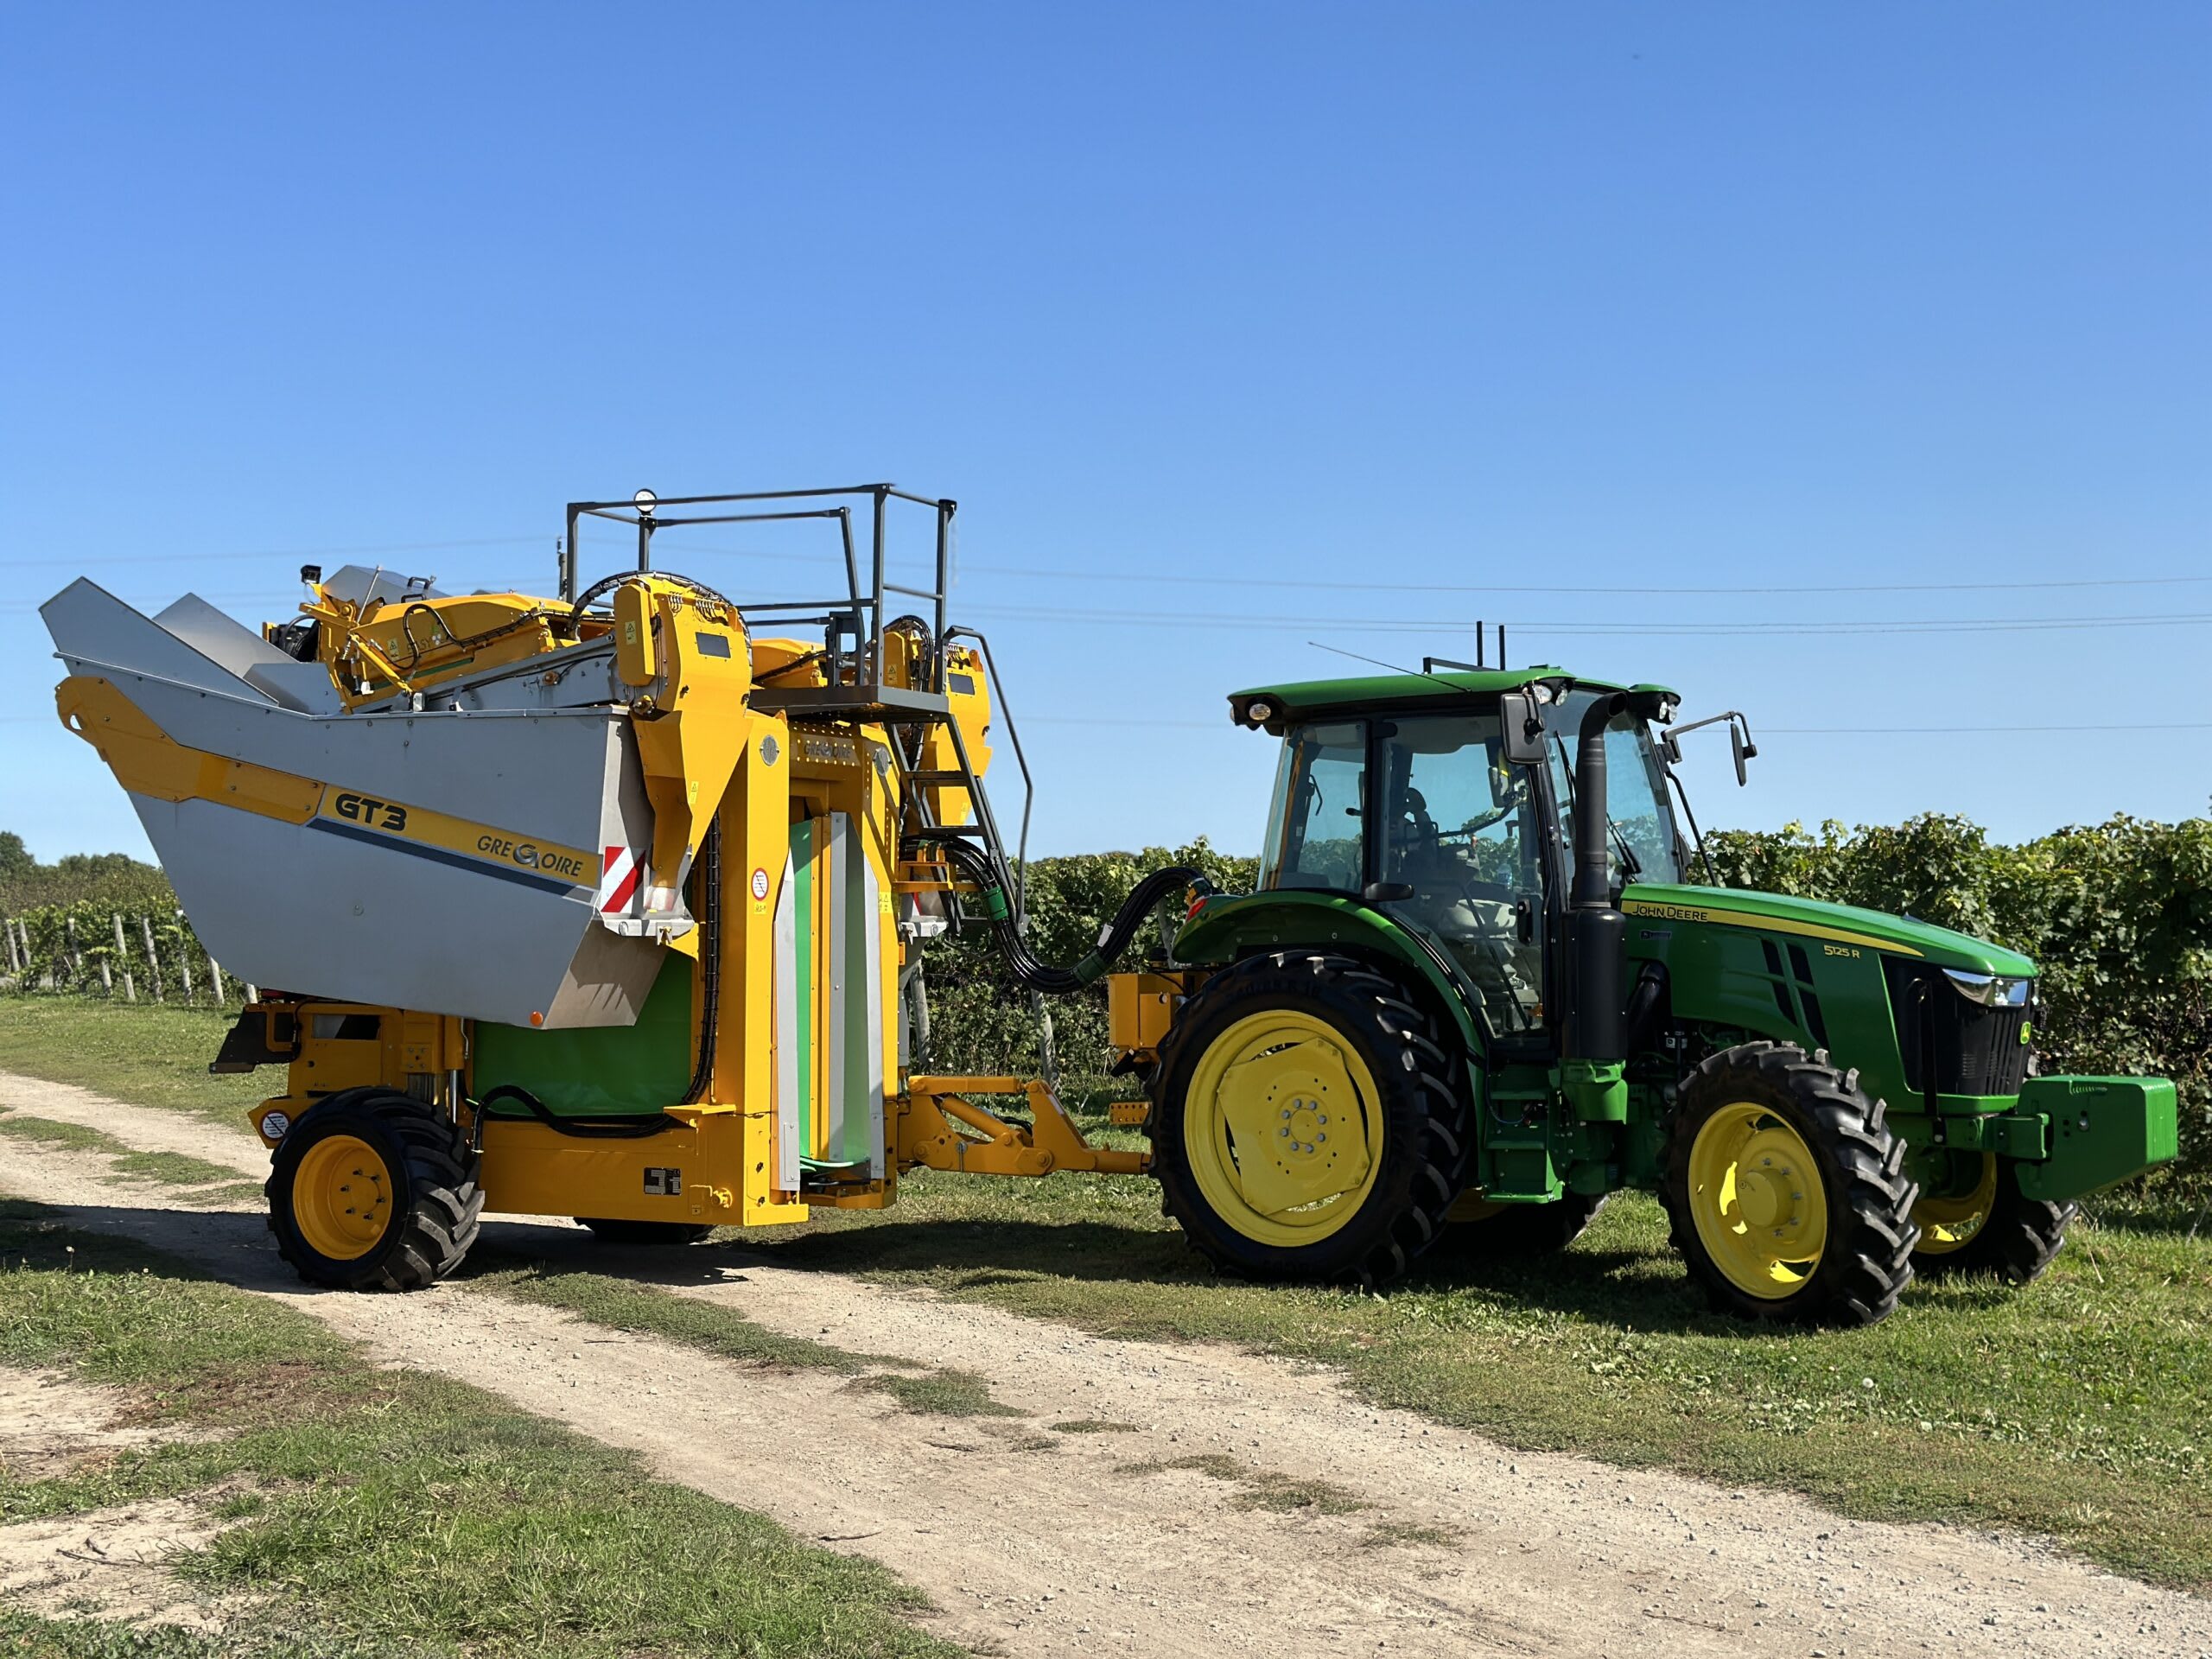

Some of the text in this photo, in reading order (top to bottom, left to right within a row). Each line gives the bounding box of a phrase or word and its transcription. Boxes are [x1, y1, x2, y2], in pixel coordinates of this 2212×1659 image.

[335, 793, 408, 832] GT3
[477, 835, 584, 877] GREGOIRE
[1632, 904, 1708, 921] JOHN DEERE
[1823, 944, 1860, 959] 5125 R
